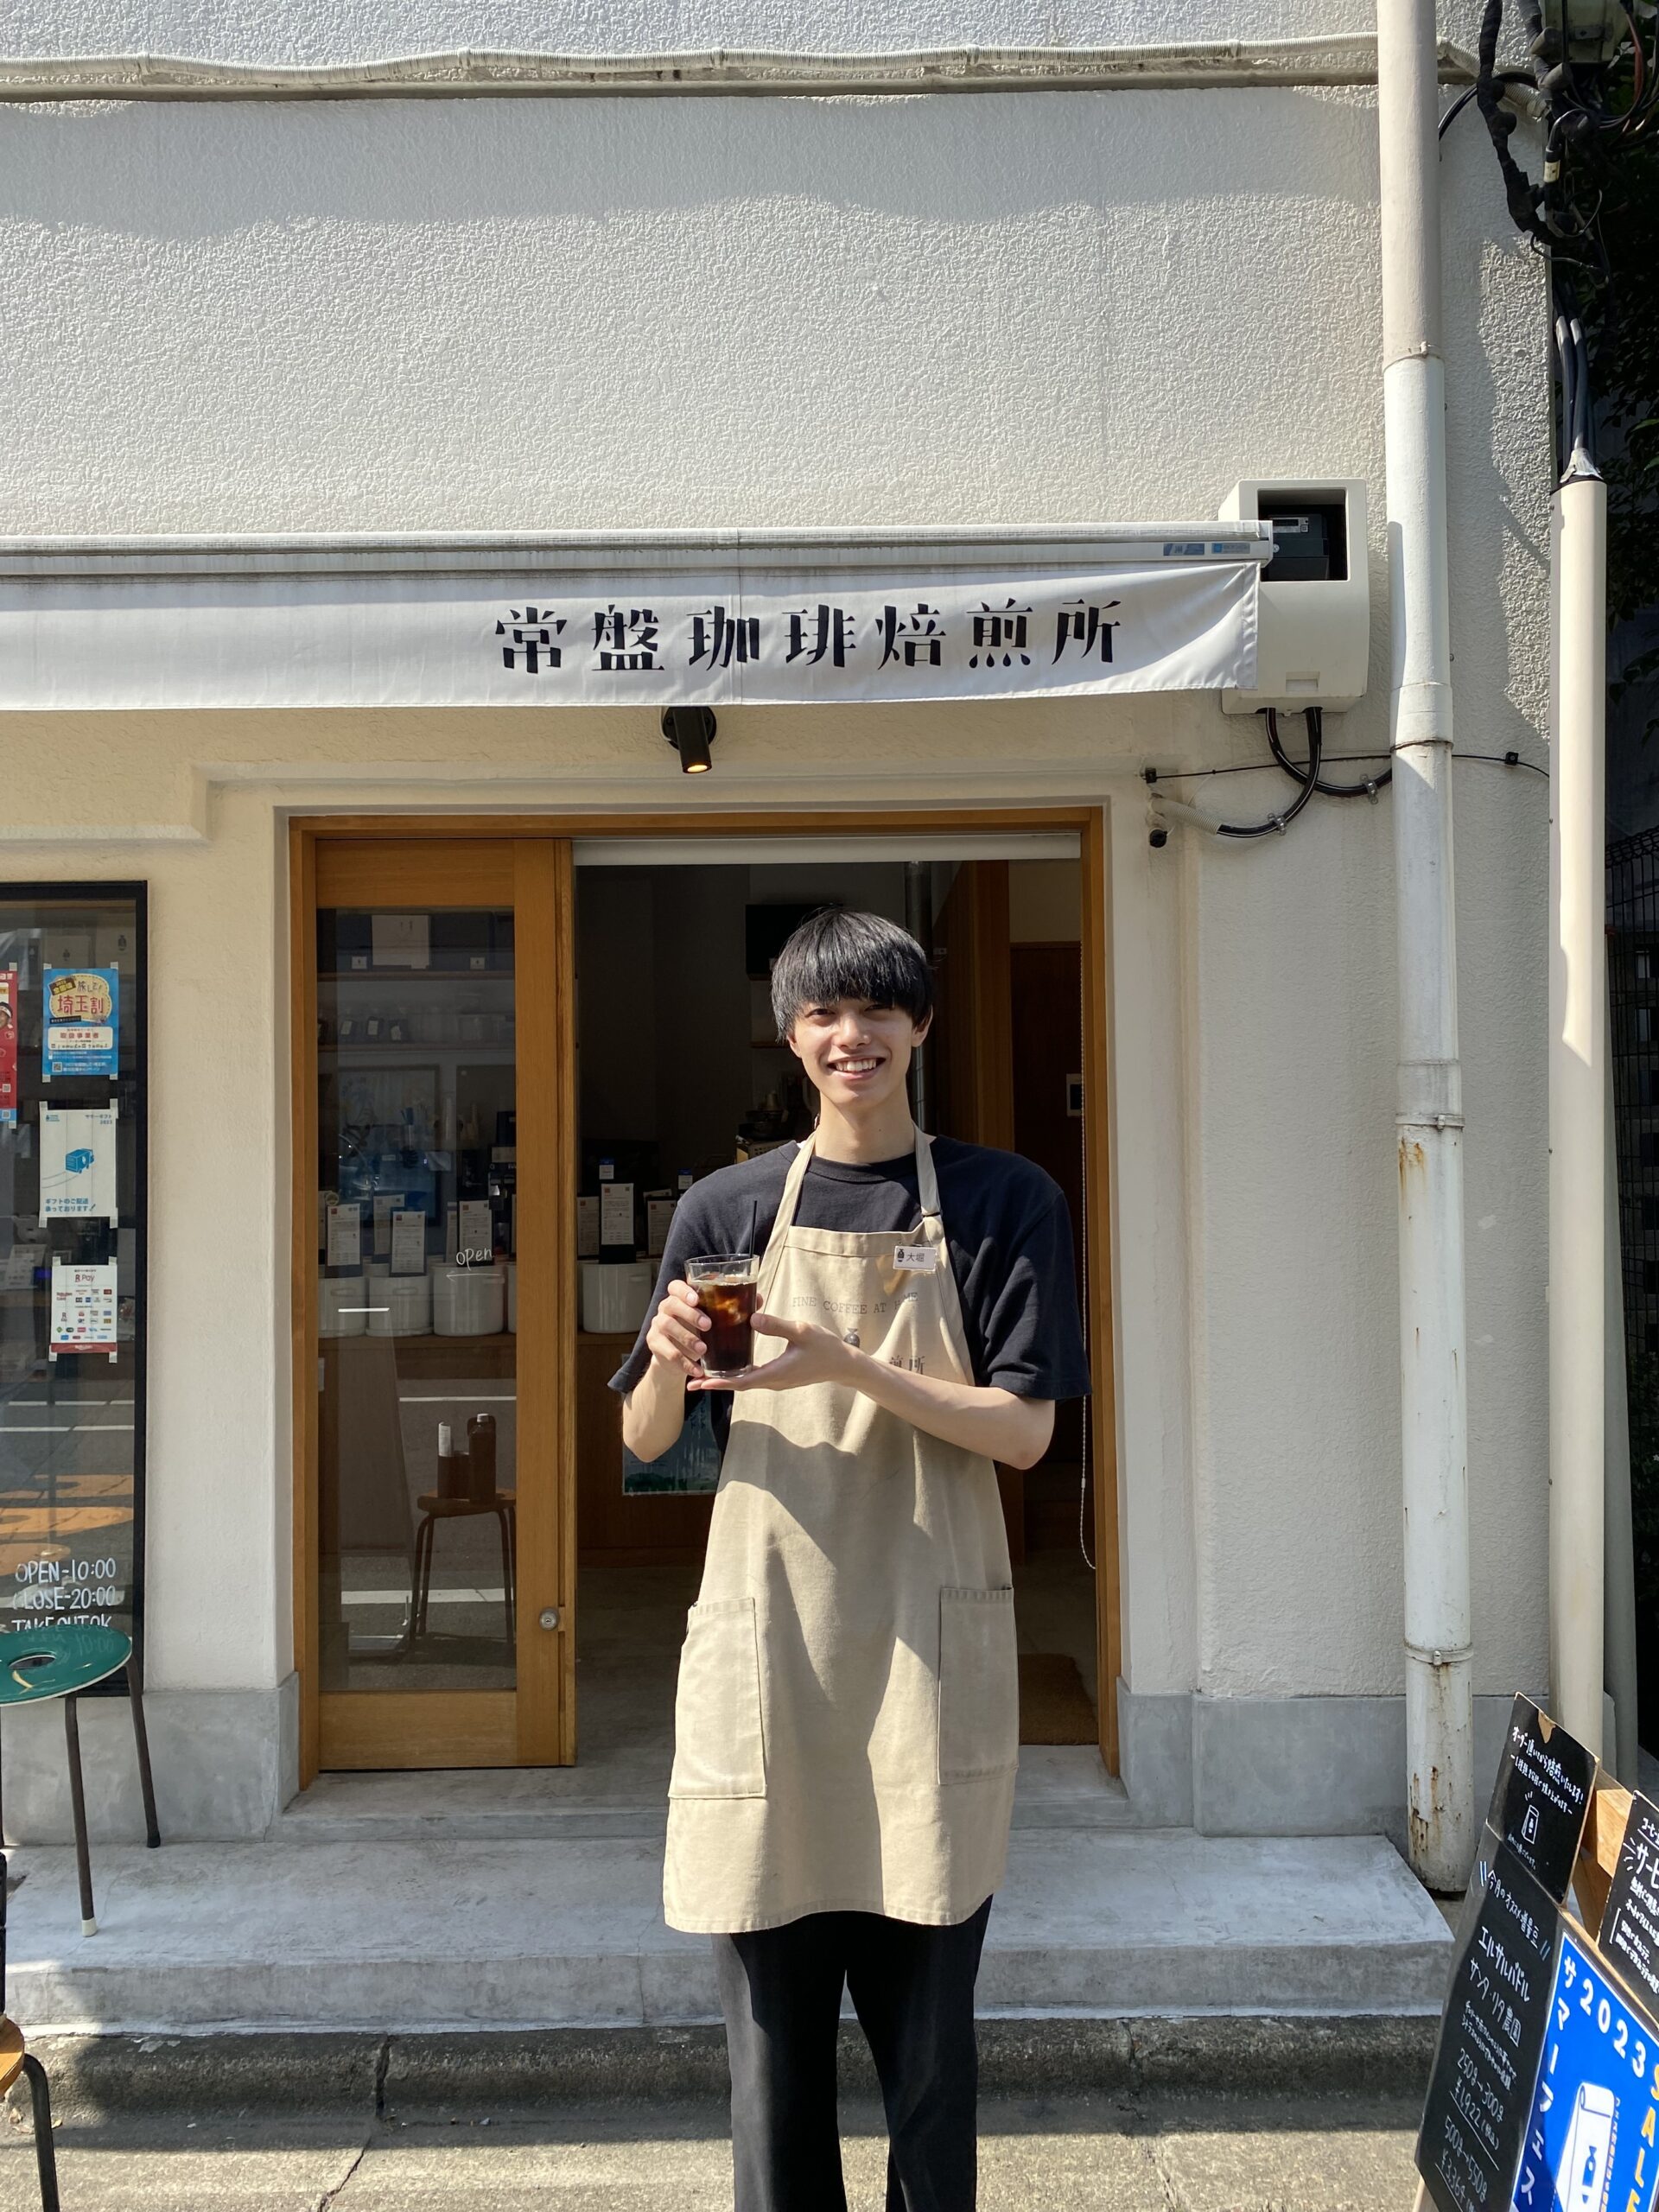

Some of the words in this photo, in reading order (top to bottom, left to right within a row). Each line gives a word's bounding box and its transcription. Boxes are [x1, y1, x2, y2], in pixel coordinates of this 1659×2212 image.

[494, 599, 1122, 674] 常盤珈琲焙煎所
[57, 995, 104, 1015] 埼玉割
[792, 1296, 817, 1307] FINE
[823, 1300, 868, 1314] COFFEE
[874, 1302, 887, 1313] AT
[894, 1292, 918, 1310] HME
[1478, 1926, 1530, 2003] エルサルバドル
[1580, 1978, 1647, 2078] 2023
